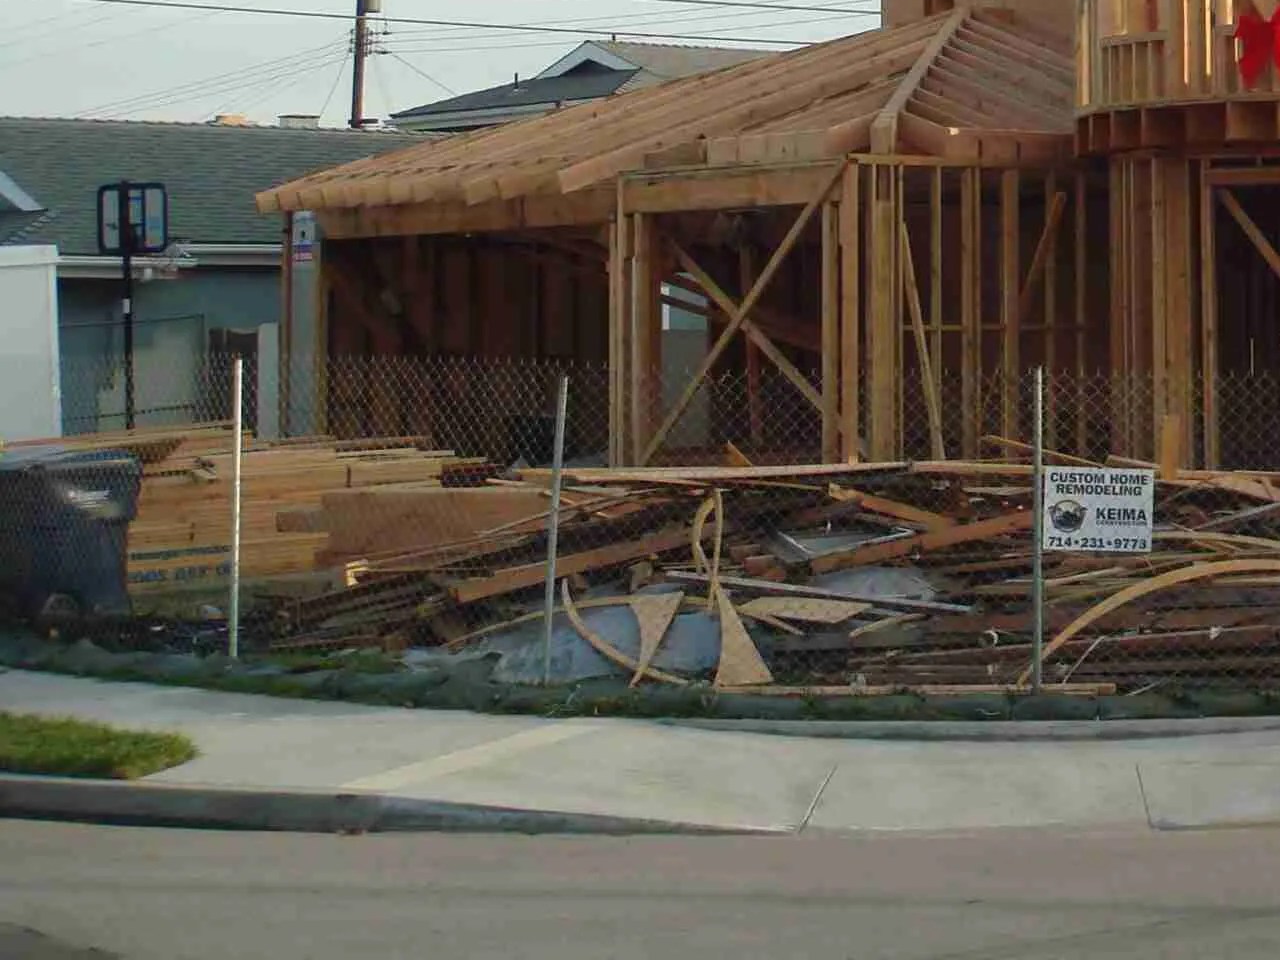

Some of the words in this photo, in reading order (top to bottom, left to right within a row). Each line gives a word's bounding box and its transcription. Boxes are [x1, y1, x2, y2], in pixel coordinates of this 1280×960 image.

[1050, 472, 1105, 484] CUSTOM
[1110, 474, 1150, 485] HOME
[1056, 484, 1142, 496] REMODELING
[1096, 507, 1147, 520] KEIMA
